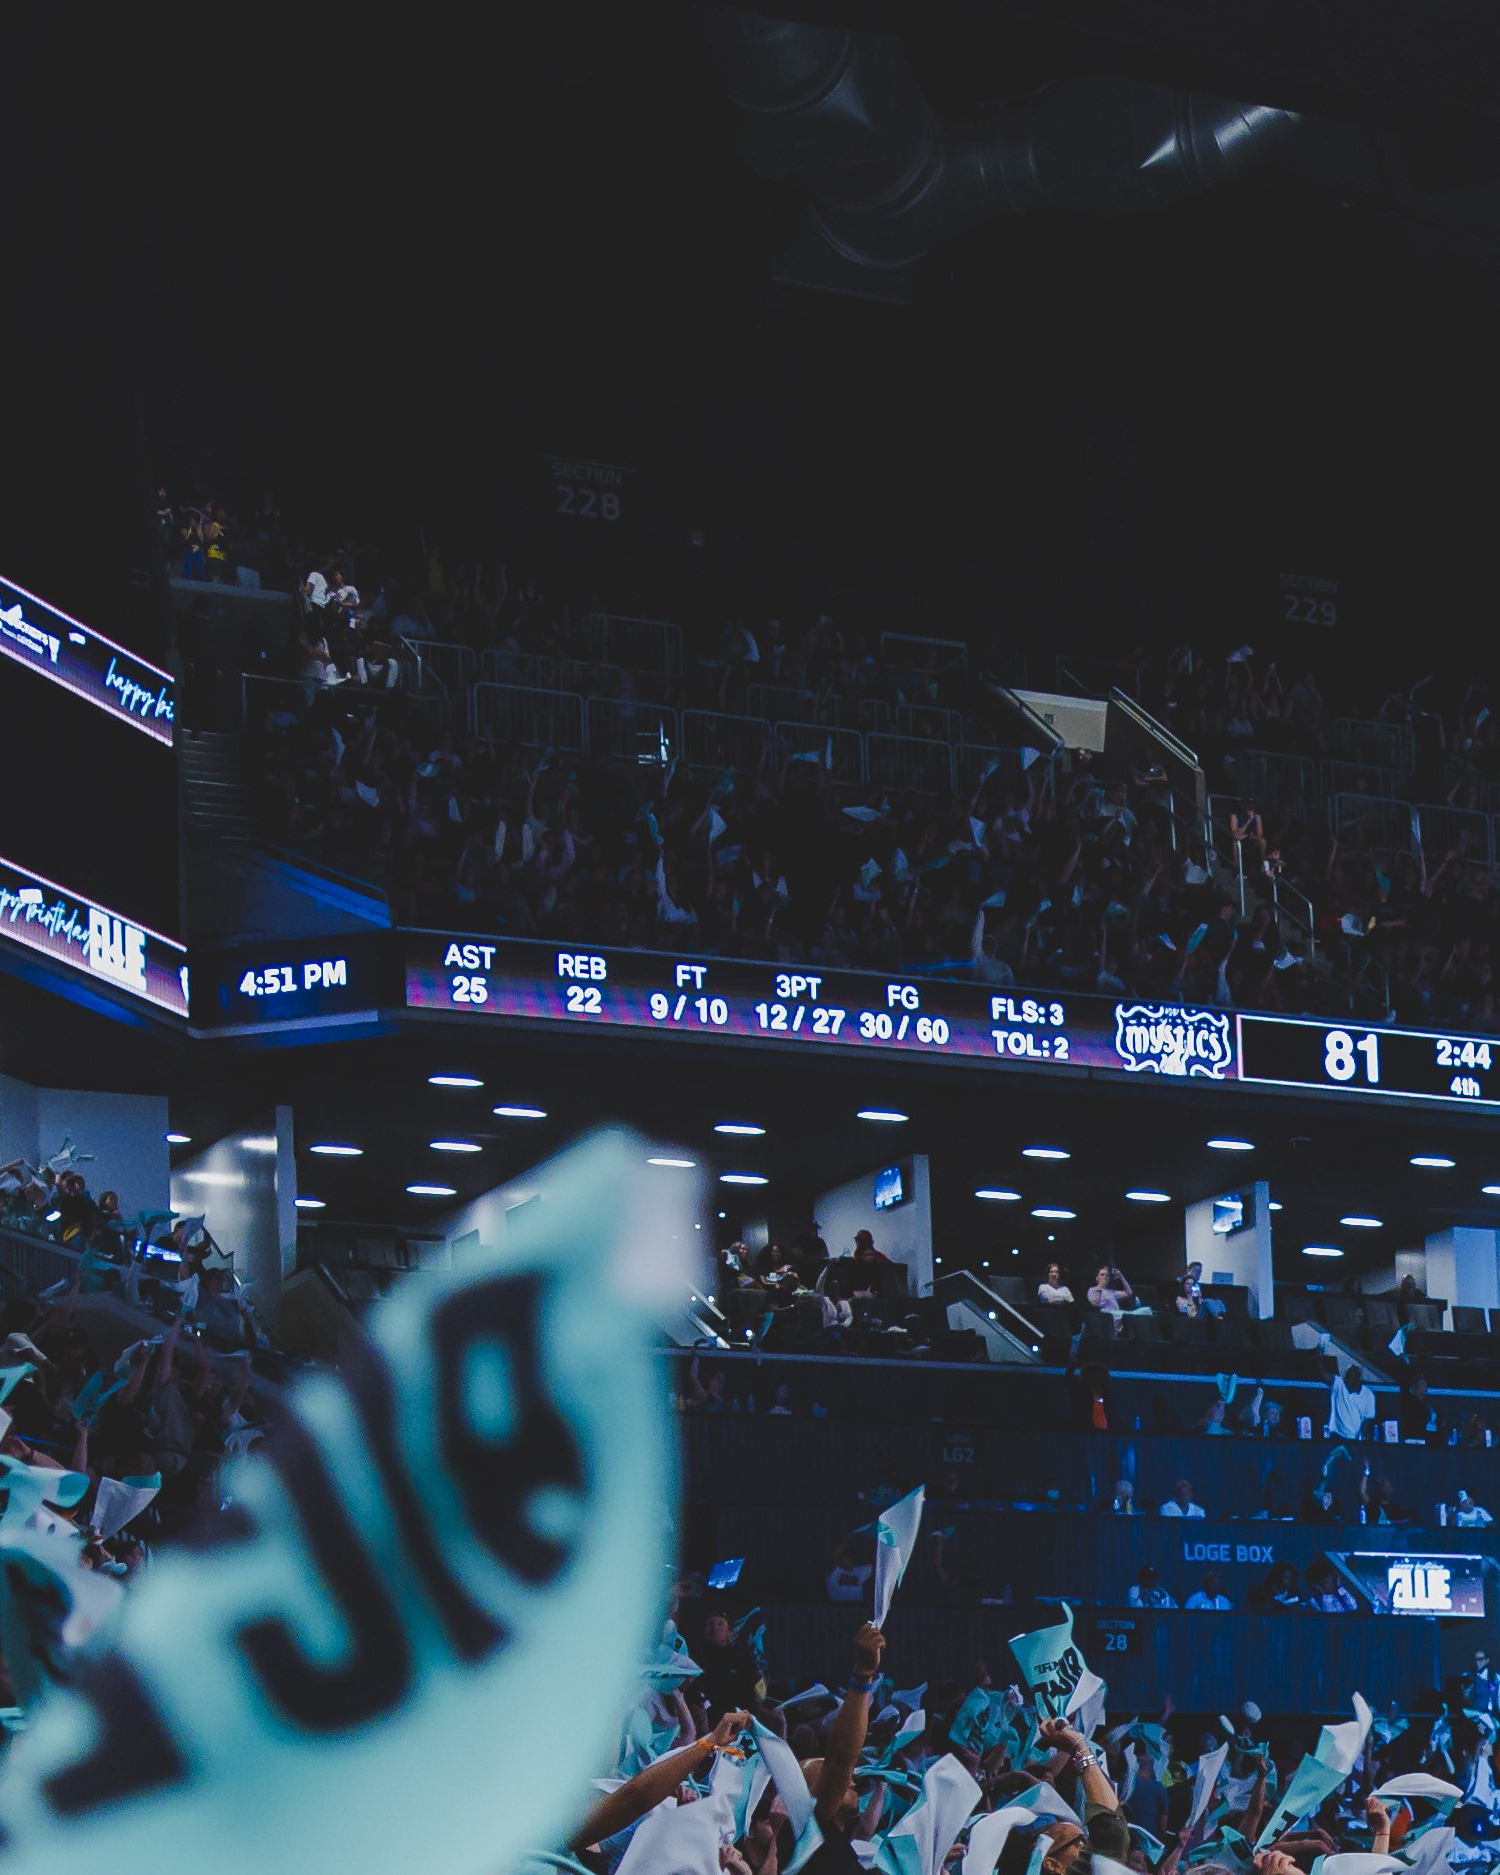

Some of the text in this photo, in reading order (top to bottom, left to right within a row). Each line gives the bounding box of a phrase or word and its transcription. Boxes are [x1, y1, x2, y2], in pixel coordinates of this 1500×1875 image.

[556, 485, 621, 521] 228
[1283, 594, 1338, 627] 229
[104, 656, 157, 718] happy
[89, 907, 147, 994] ELLIE
[444, 943, 497, 971] AST
[239, 959, 349, 998] 4:51 PM
[557, 953, 608, 980] REB
[675, 965, 708, 990] FT
[451, 976, 489, 1004] 25
[565, 985, 604, 1014] 22
[775, 974, 821, 1001] 3PT
[886, 985, 919, 1011] FG
[1323, 1029, 1379, 1084] 81
[1435, 1039, 1490, 1071] 2:44
[1449, 1076, 1483, 1098] 4th
[943, 1446, 976, 1464] LG2
[1182, 1542, 1275, 1564] LOGE BOX
[1104, 1633, 1128, 1652] 28
